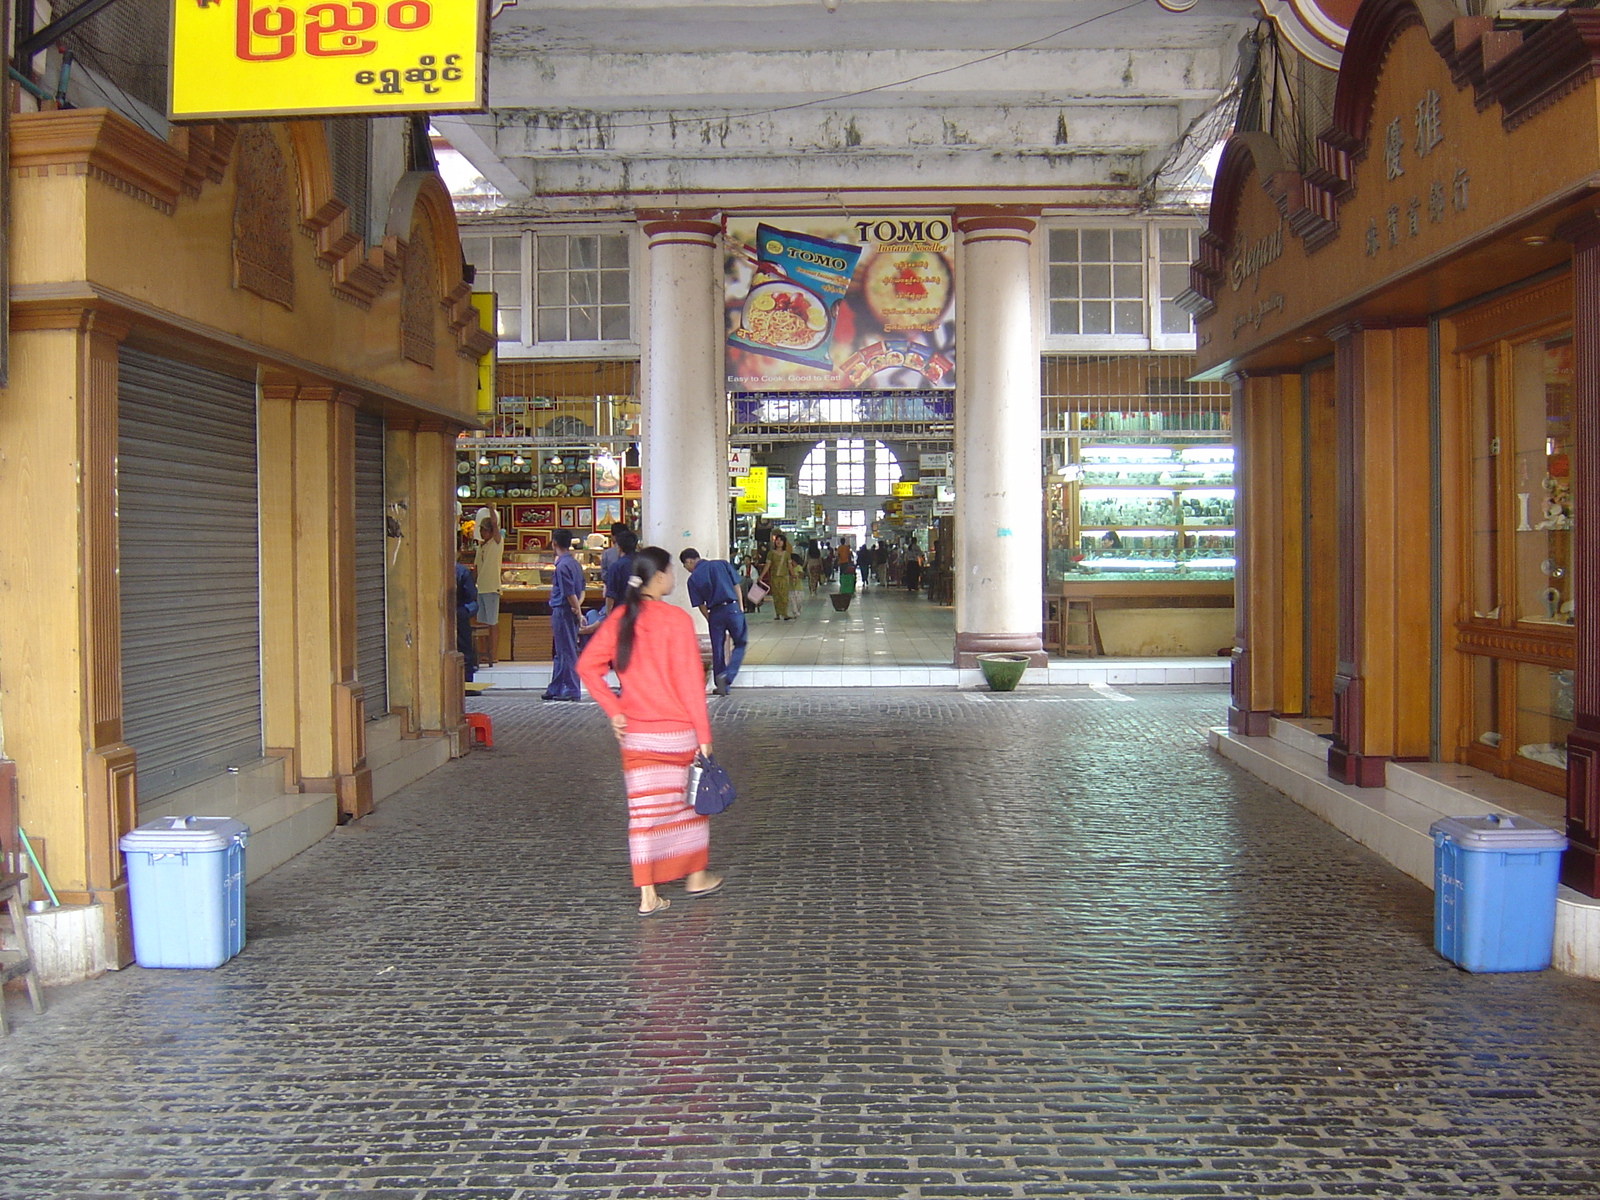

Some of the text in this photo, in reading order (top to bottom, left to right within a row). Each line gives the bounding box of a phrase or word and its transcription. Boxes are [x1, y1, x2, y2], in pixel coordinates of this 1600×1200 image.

[854, 220, 950, 242] TOMO
[877, 242, 948, 253] Instant Noodles
[1231, 217, 1283, 291] Elegant
[787, 247, 847, 271] TOMO
[727, 375, 750, 384] Easy
